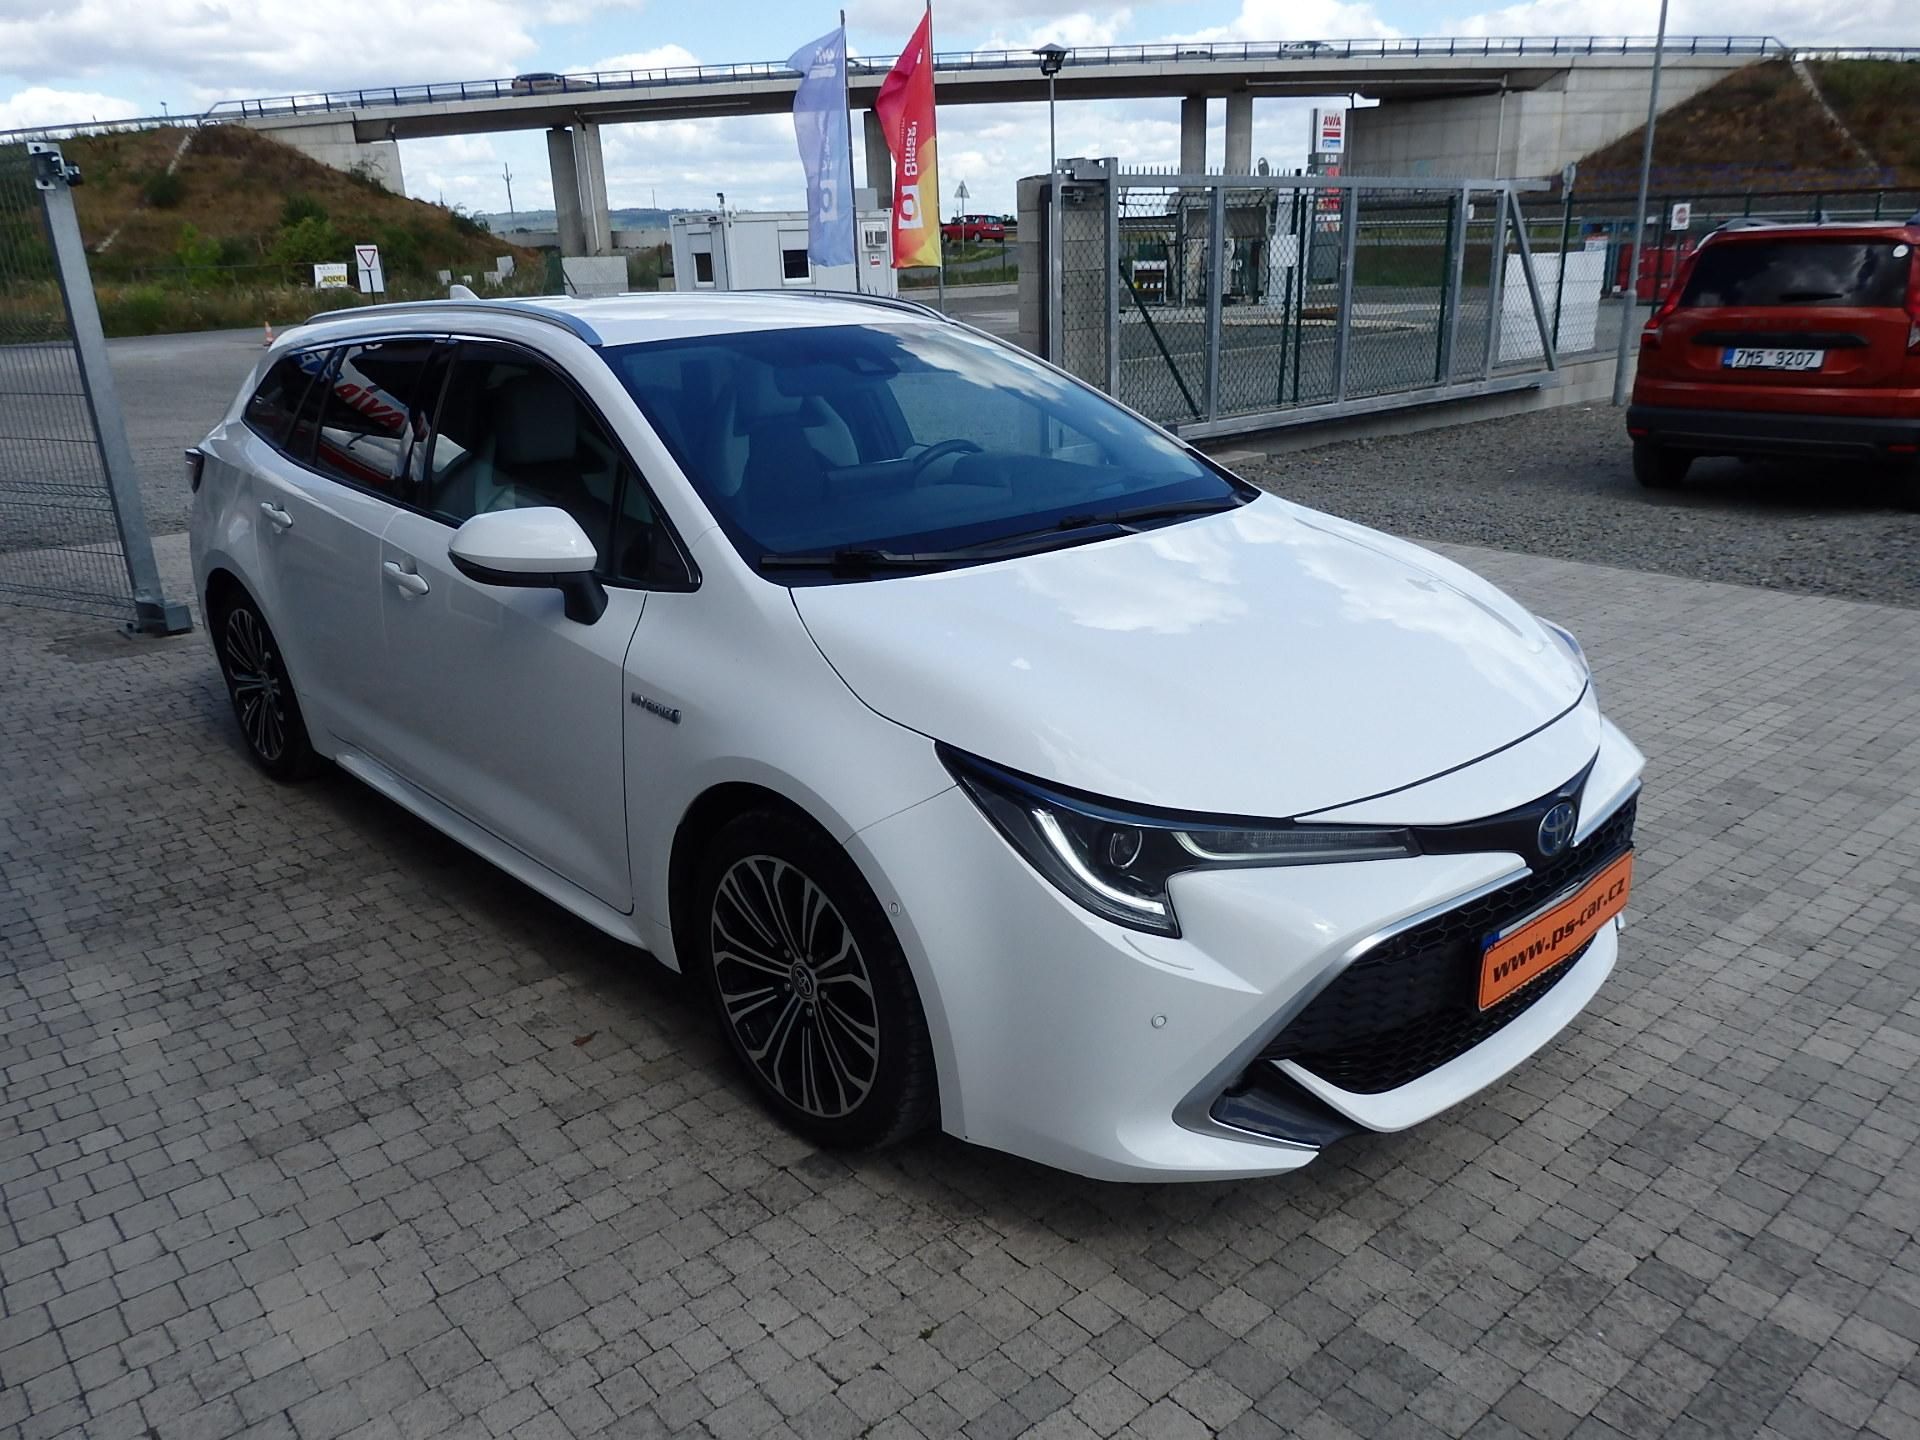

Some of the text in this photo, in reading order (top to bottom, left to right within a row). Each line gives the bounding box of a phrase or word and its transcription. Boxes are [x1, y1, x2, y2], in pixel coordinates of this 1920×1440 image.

[1736, 350, 1816, 366] 7M5 9207
[1493, 877, 1625, 982] www.ps-car.cz
